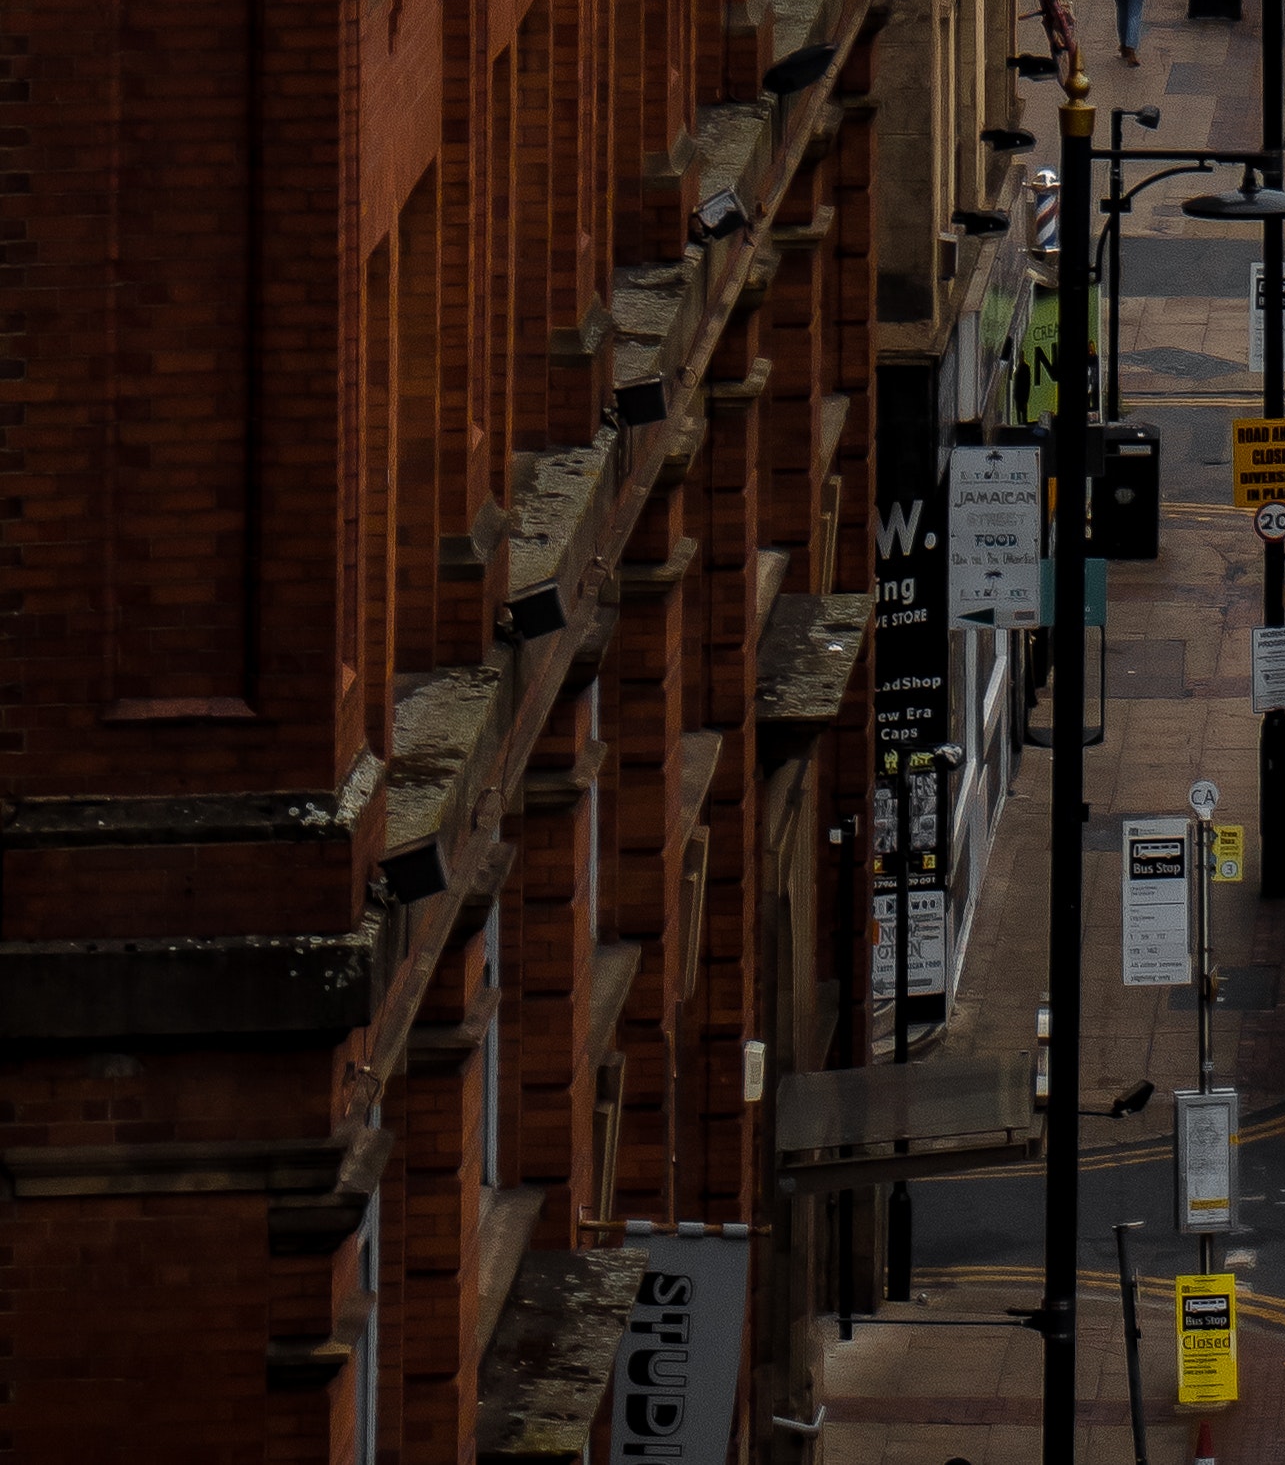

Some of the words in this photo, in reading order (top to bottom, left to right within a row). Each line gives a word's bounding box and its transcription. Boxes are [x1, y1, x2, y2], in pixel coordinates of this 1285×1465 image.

[1237, 426, 1269, 444] ROAD
[957, 491, 1036, 507] JAMAICAN
[1246, 488, 1260, 501] IN
[974, 533, 1018, 547] FOOD
[891, 608, 928, 627] STORE
[905, 707, 933, 721] Era
[880, 727, 919, 741] Caps
[1191, 789, 1215, 806] CA
[1133, 862, 1153, 875] Bus
[1155, 862, 1181, 877] Stop
[1225, 863, 1235, 875] 3
[1185, 1316, 1203, 1327] Bus
[1205, 1314, 1228, 1328] Stop
[1182, 1333, 1231, 1350] Closed
[622, 1271, 693, 1465] STUDI
